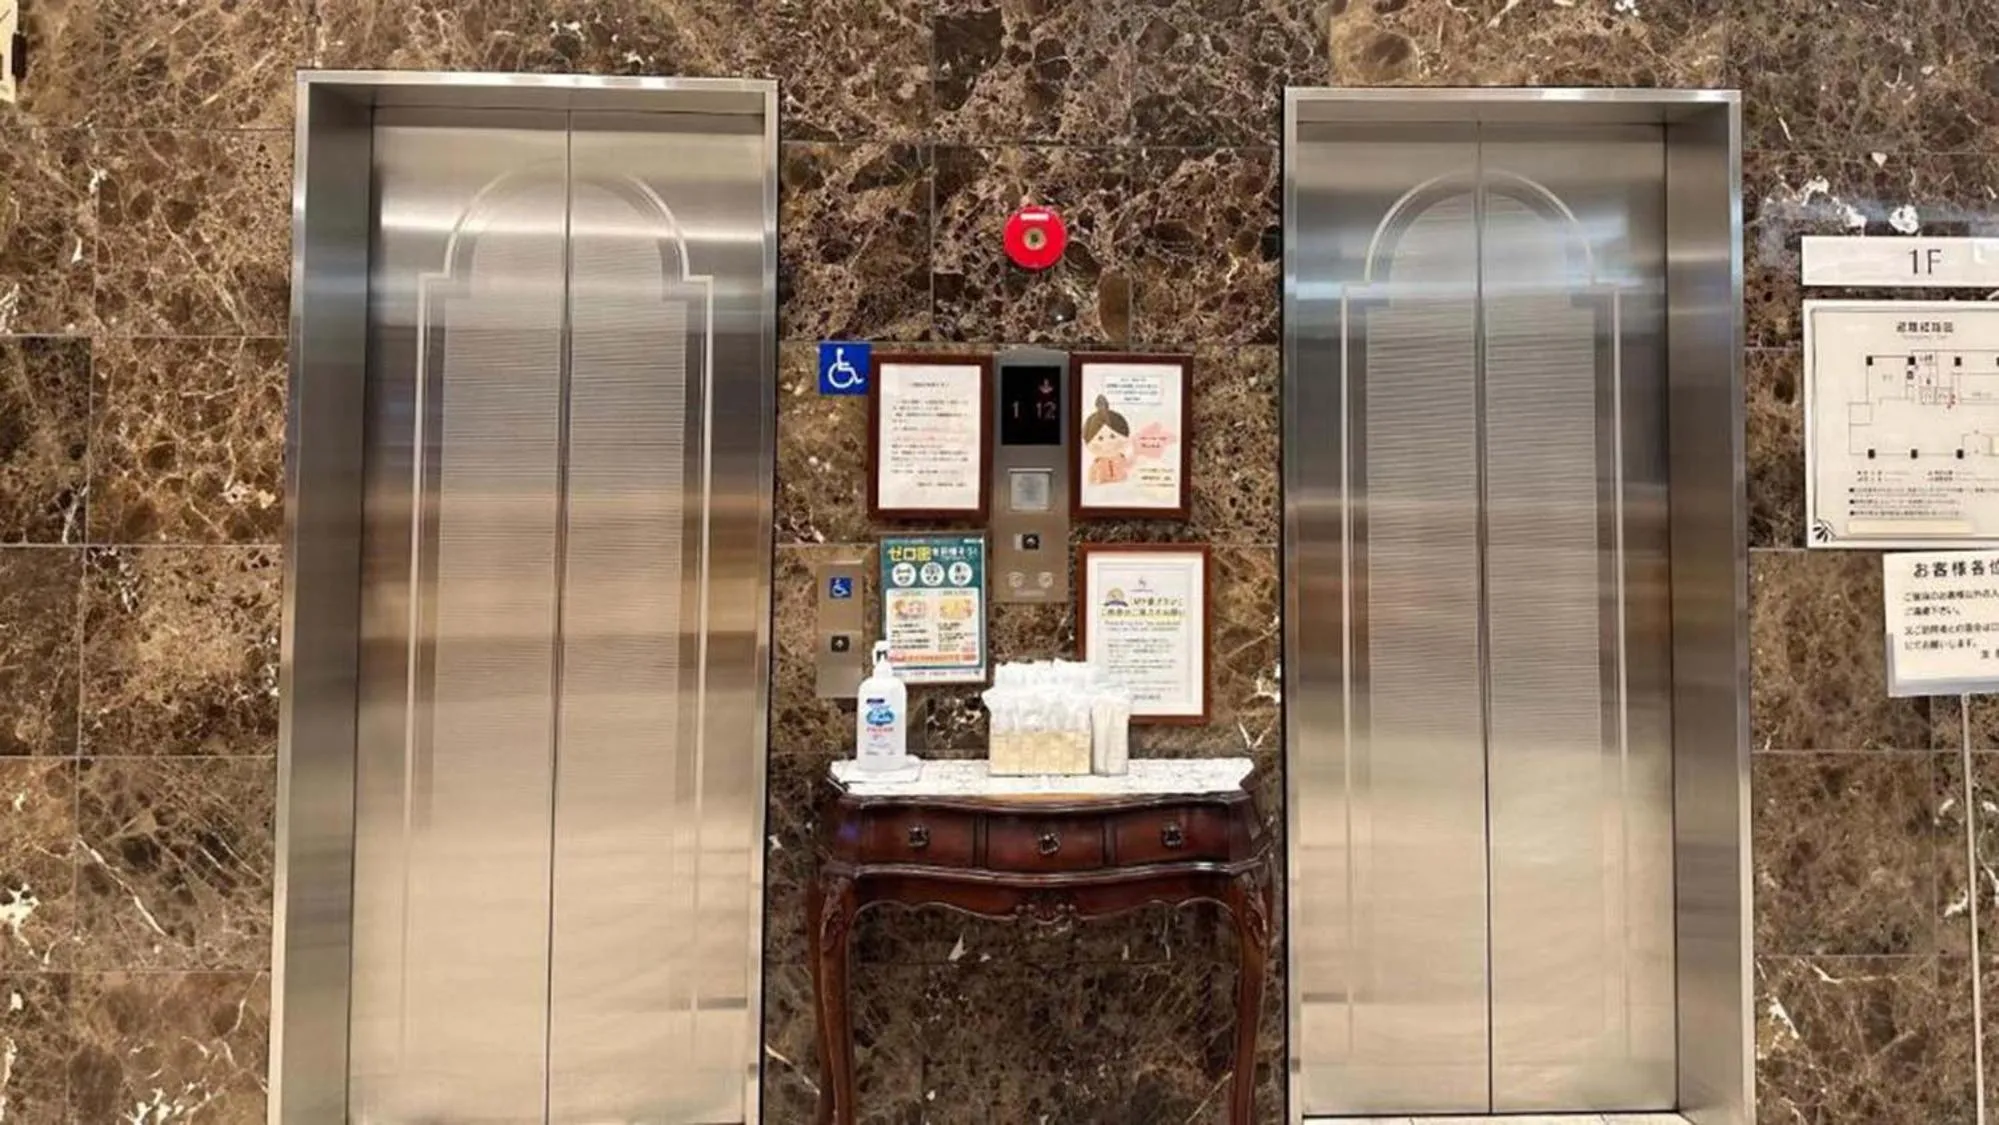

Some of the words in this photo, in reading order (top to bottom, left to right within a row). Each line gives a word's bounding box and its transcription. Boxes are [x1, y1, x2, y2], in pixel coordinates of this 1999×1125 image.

[1908, 248, 1942, 275] 1F
[1012, 401, 1020, 419] 1
[1035, 401, 1057, 420] 12
